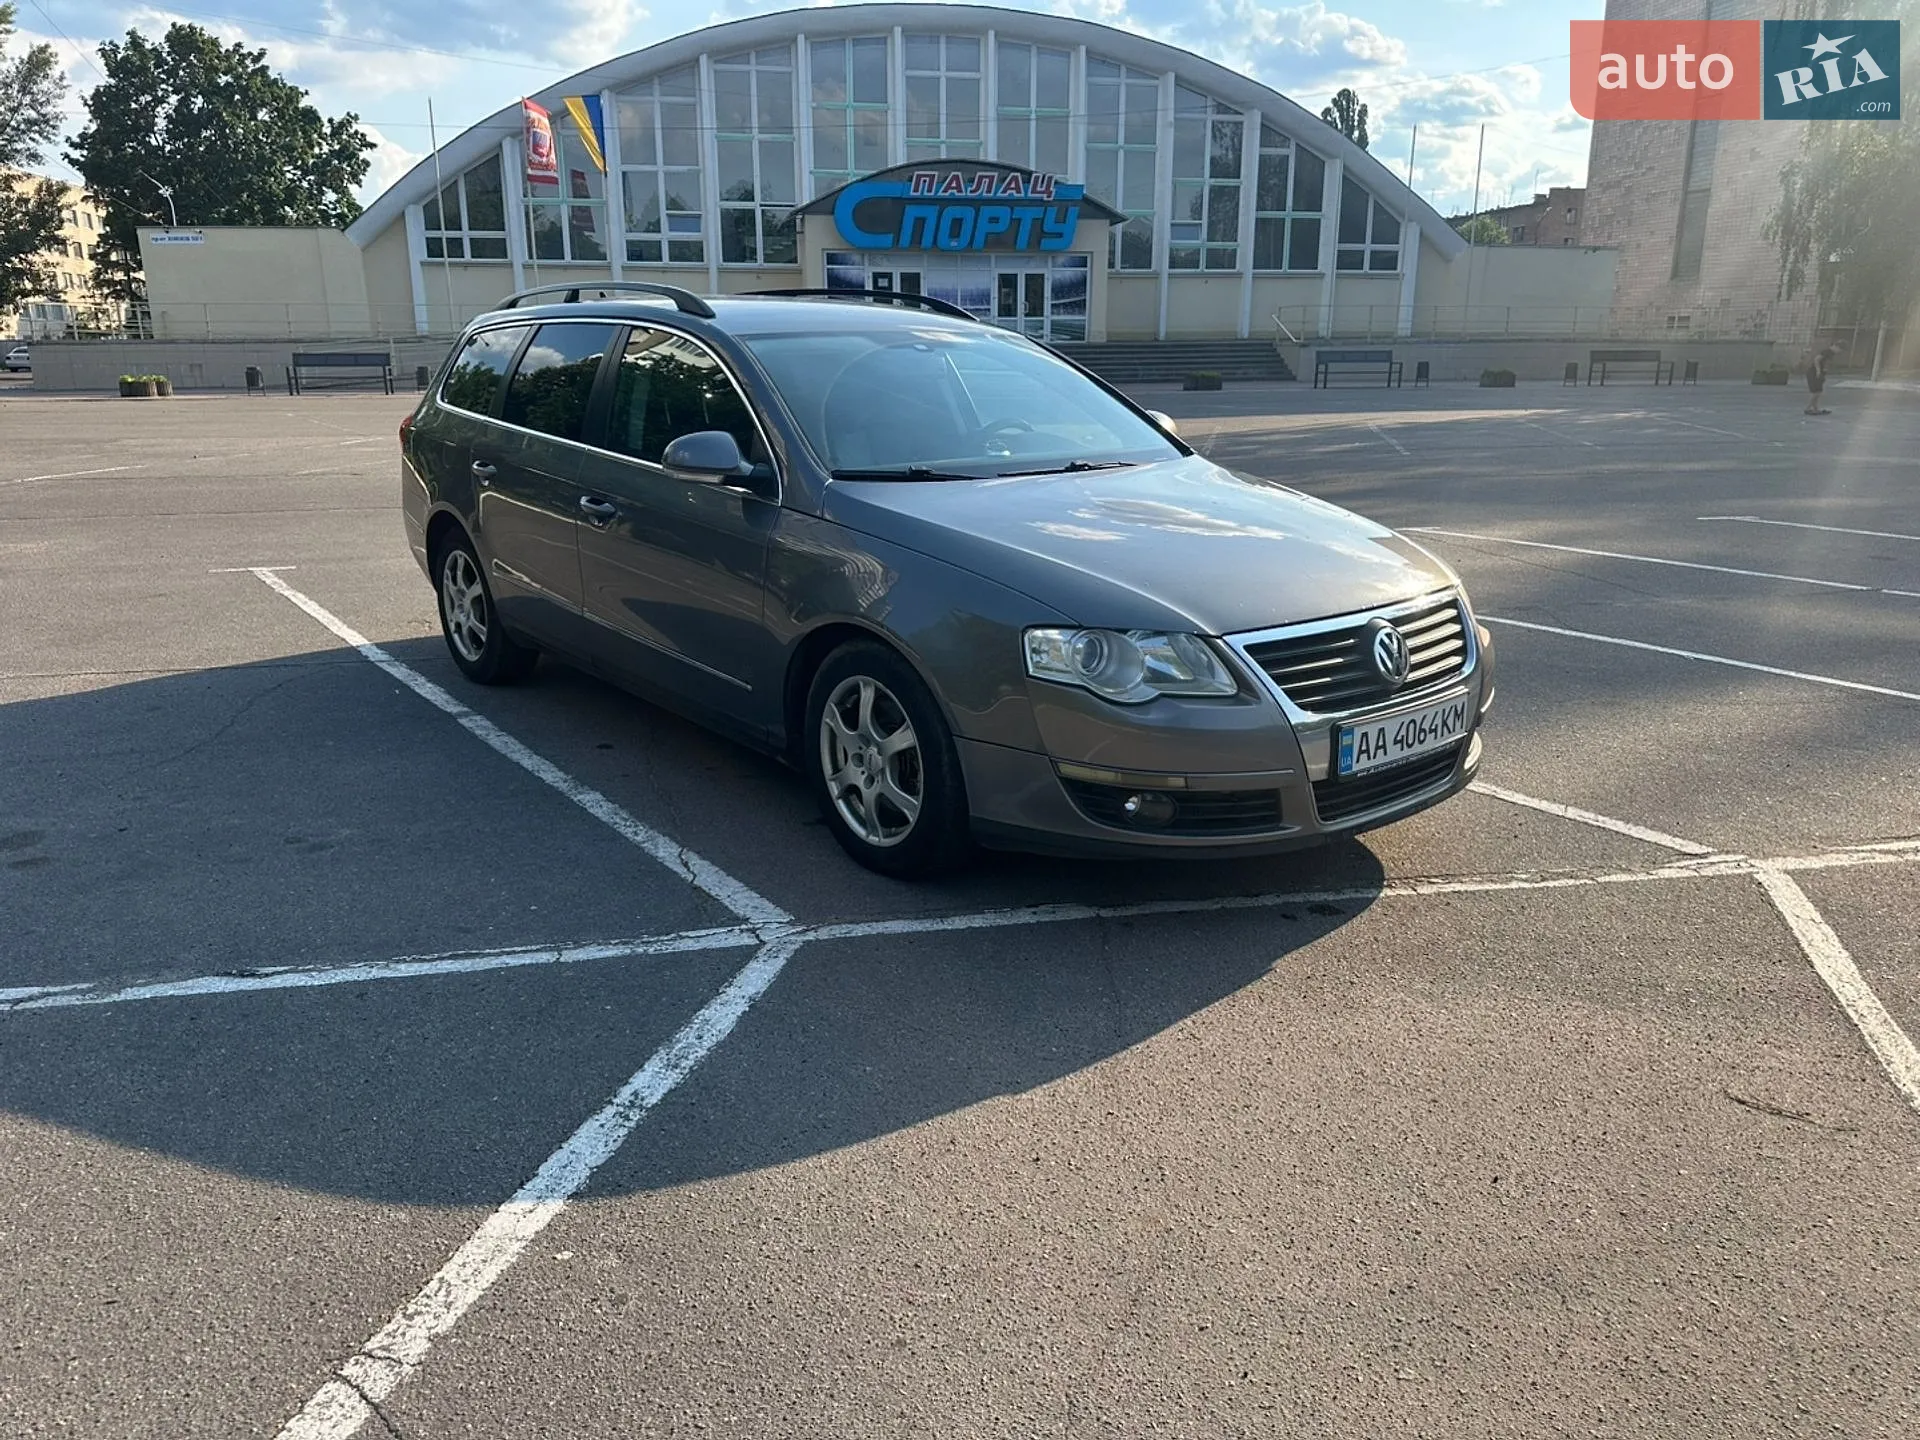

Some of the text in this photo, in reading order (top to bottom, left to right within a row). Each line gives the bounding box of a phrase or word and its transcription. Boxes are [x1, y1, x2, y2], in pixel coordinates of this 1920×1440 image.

[911, 171, 1056, 200] ПАЛАЦ
[833, 181, 1084, 251] СПОРТУ
[1356, 726, 1388, 764] AA
